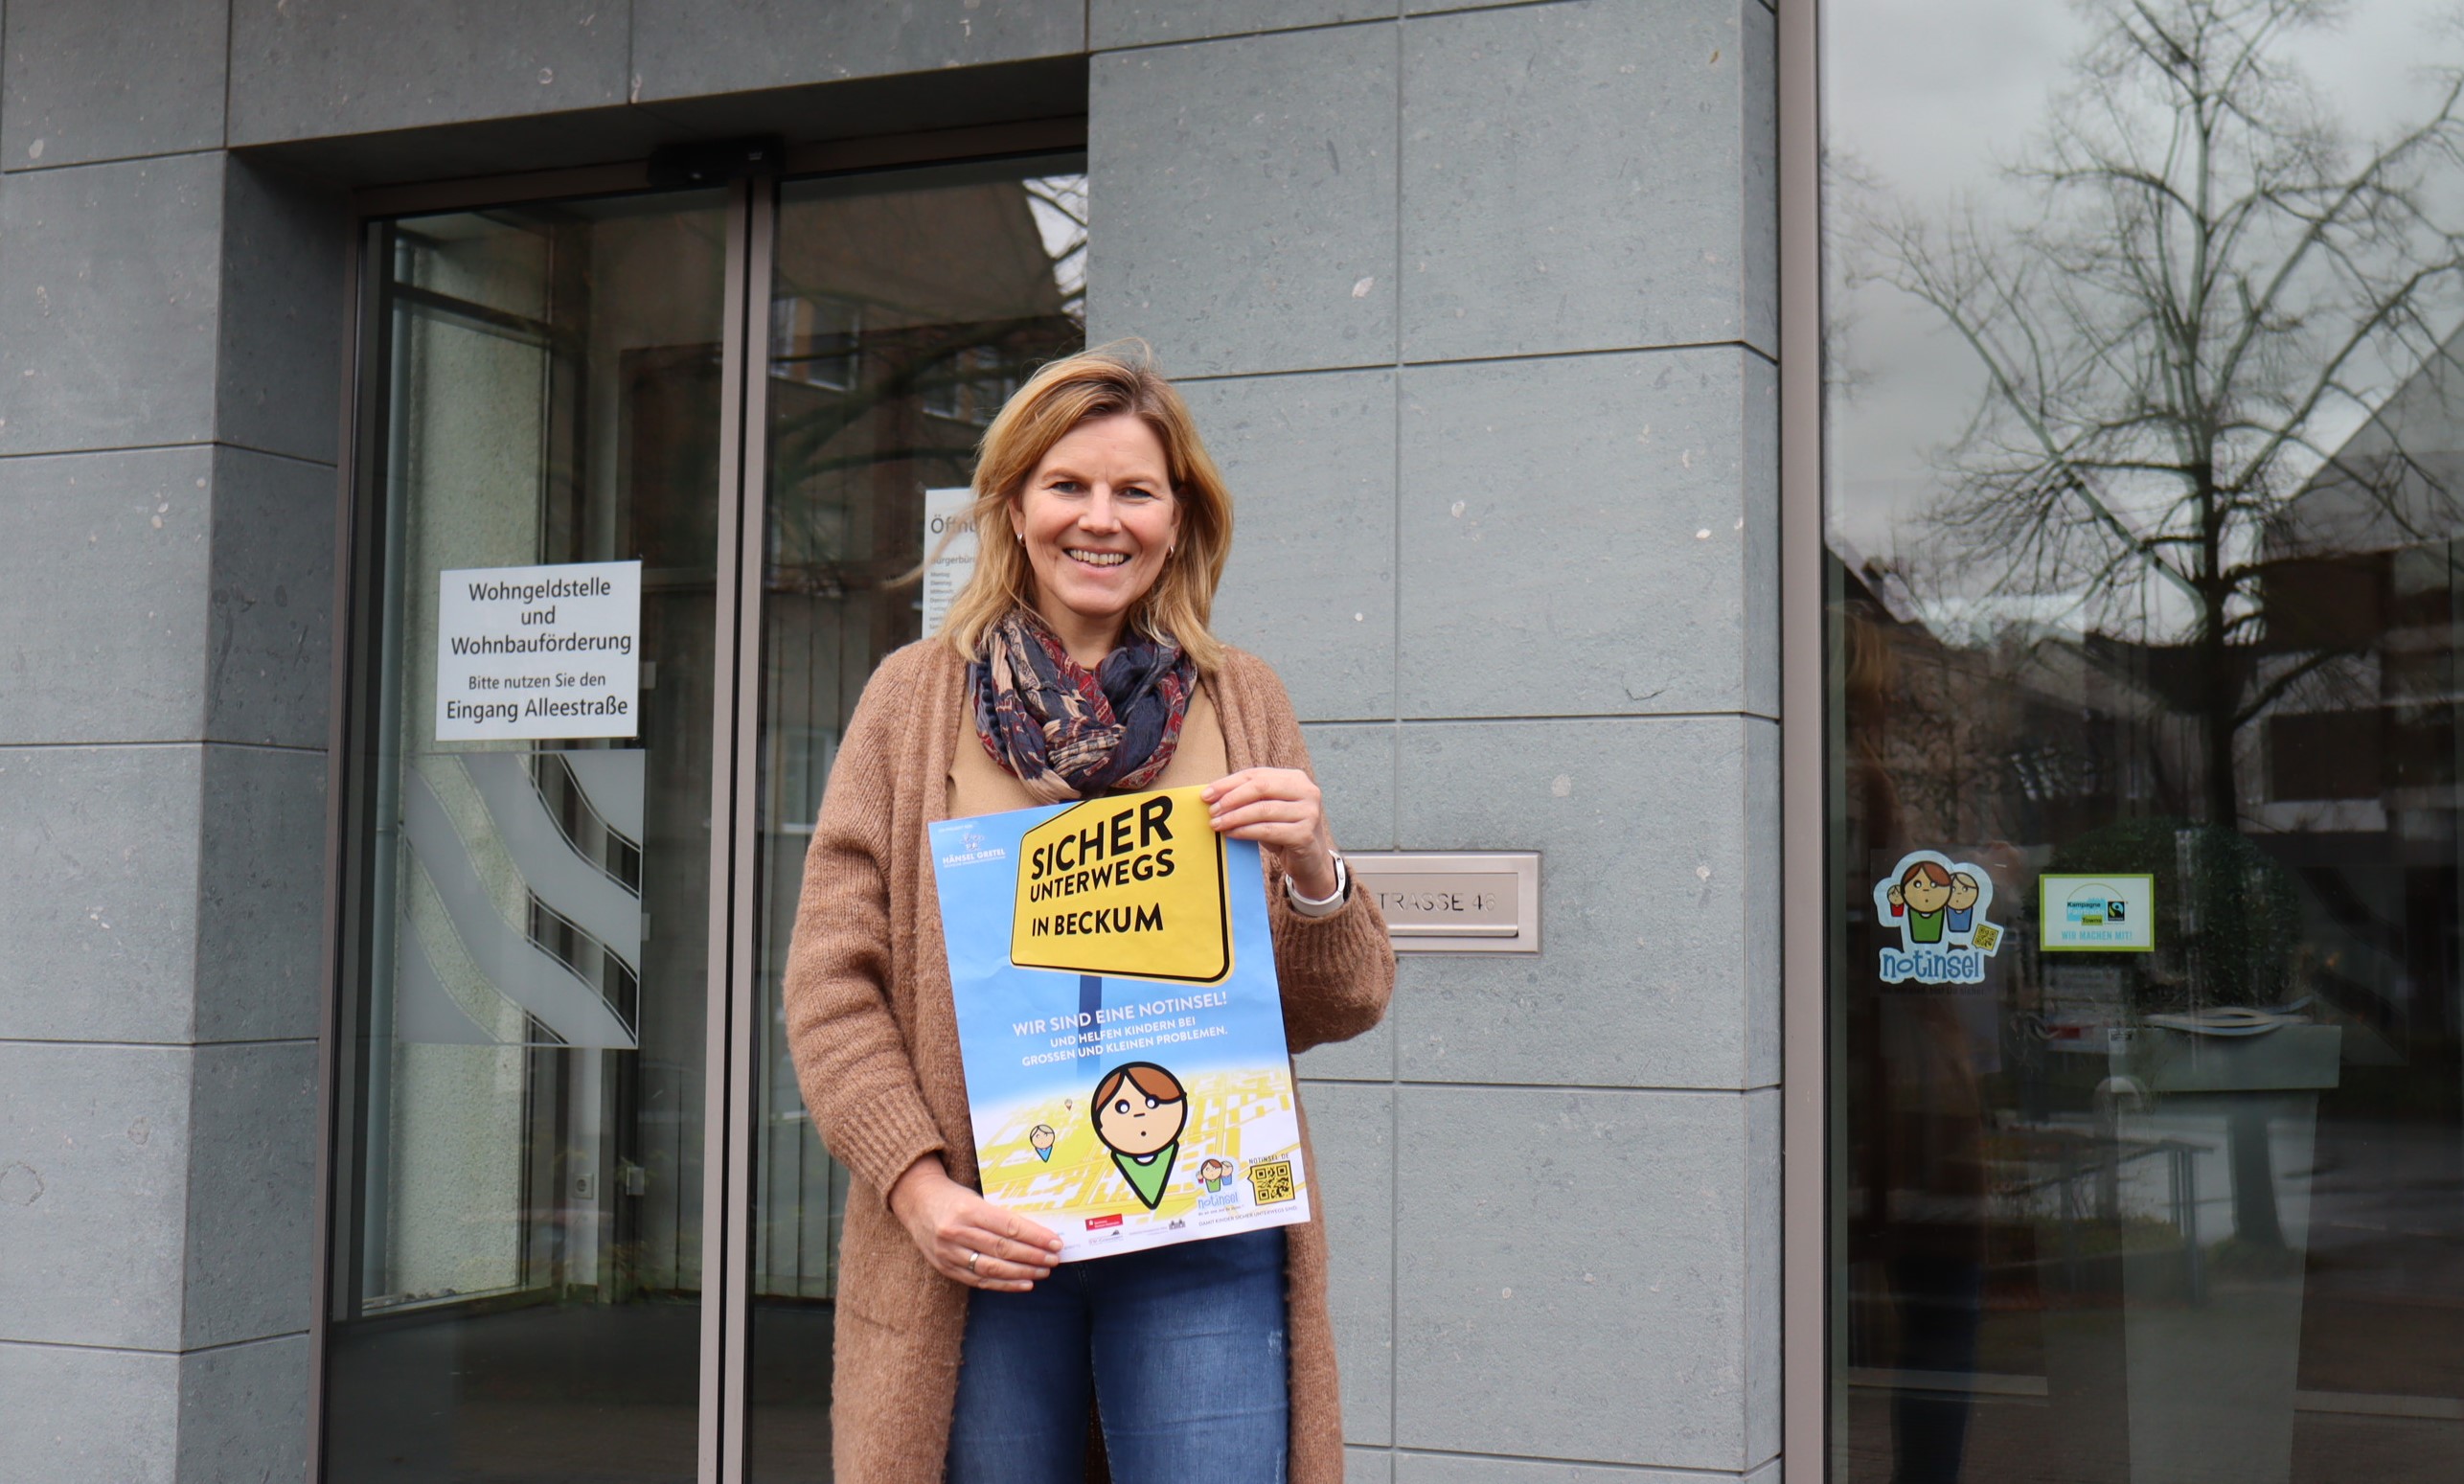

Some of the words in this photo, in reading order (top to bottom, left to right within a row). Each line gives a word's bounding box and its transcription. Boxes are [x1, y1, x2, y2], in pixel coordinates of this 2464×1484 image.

[469, 577, 610, 605] Wohngeldstelle
[521, 605, 556, 625] und
[451, 632, 631, 654] Wohnbauförderung
[468, 675, 499, 690] Bitte
[504, 674, 551, 689] nutzen
[556, 673, 575, 688] Sie
[580, 673, 605, 686] den
[447, 700, 518, 723] Eingang
[524, 696, 627, 718] Alleestraße
[1031, 795, 1174, 880] SICHER
[1030, 848, 1175, 902] UNTERWEGS
[1377, 892, 1464, 911] TRASSE
[1032, 917, 1049, 937] IN
[1054, 902, 1164, 936] BECKUM
[2062, 931, 2077, 940] WIR
[2080, 931, 2112, 940] MACHEN
[2114, 931, 2133, 940] MIT!
[1882, 950, 1979, 979] notinsel
[1012, 1018, 1046, 1037] WIR
[1050, 1012, 1091, 1032] SIND
[1096, 1005, 1135, 1024] EINE
[1139, 992, 1227, 1017] NOTINSEL!
[1021, 1050, 1076, 1066] GROSSEN
[1078, 1045, 1104, 1058] UND
[1106, 1038, 1154, 1054] KLEINEN
[1156, 1025, 1228, 1045] PROBLEMEN.
[1050, 1036, 1076, 1048] UND
[1079, 1028, 1122, 1044] HELFEN
[1125, 1019, 1176, 1037] KINDERN
[1178, 1016, 1196, 1028] BEI
[1198, 1192, 1239, 1209] notinsel
